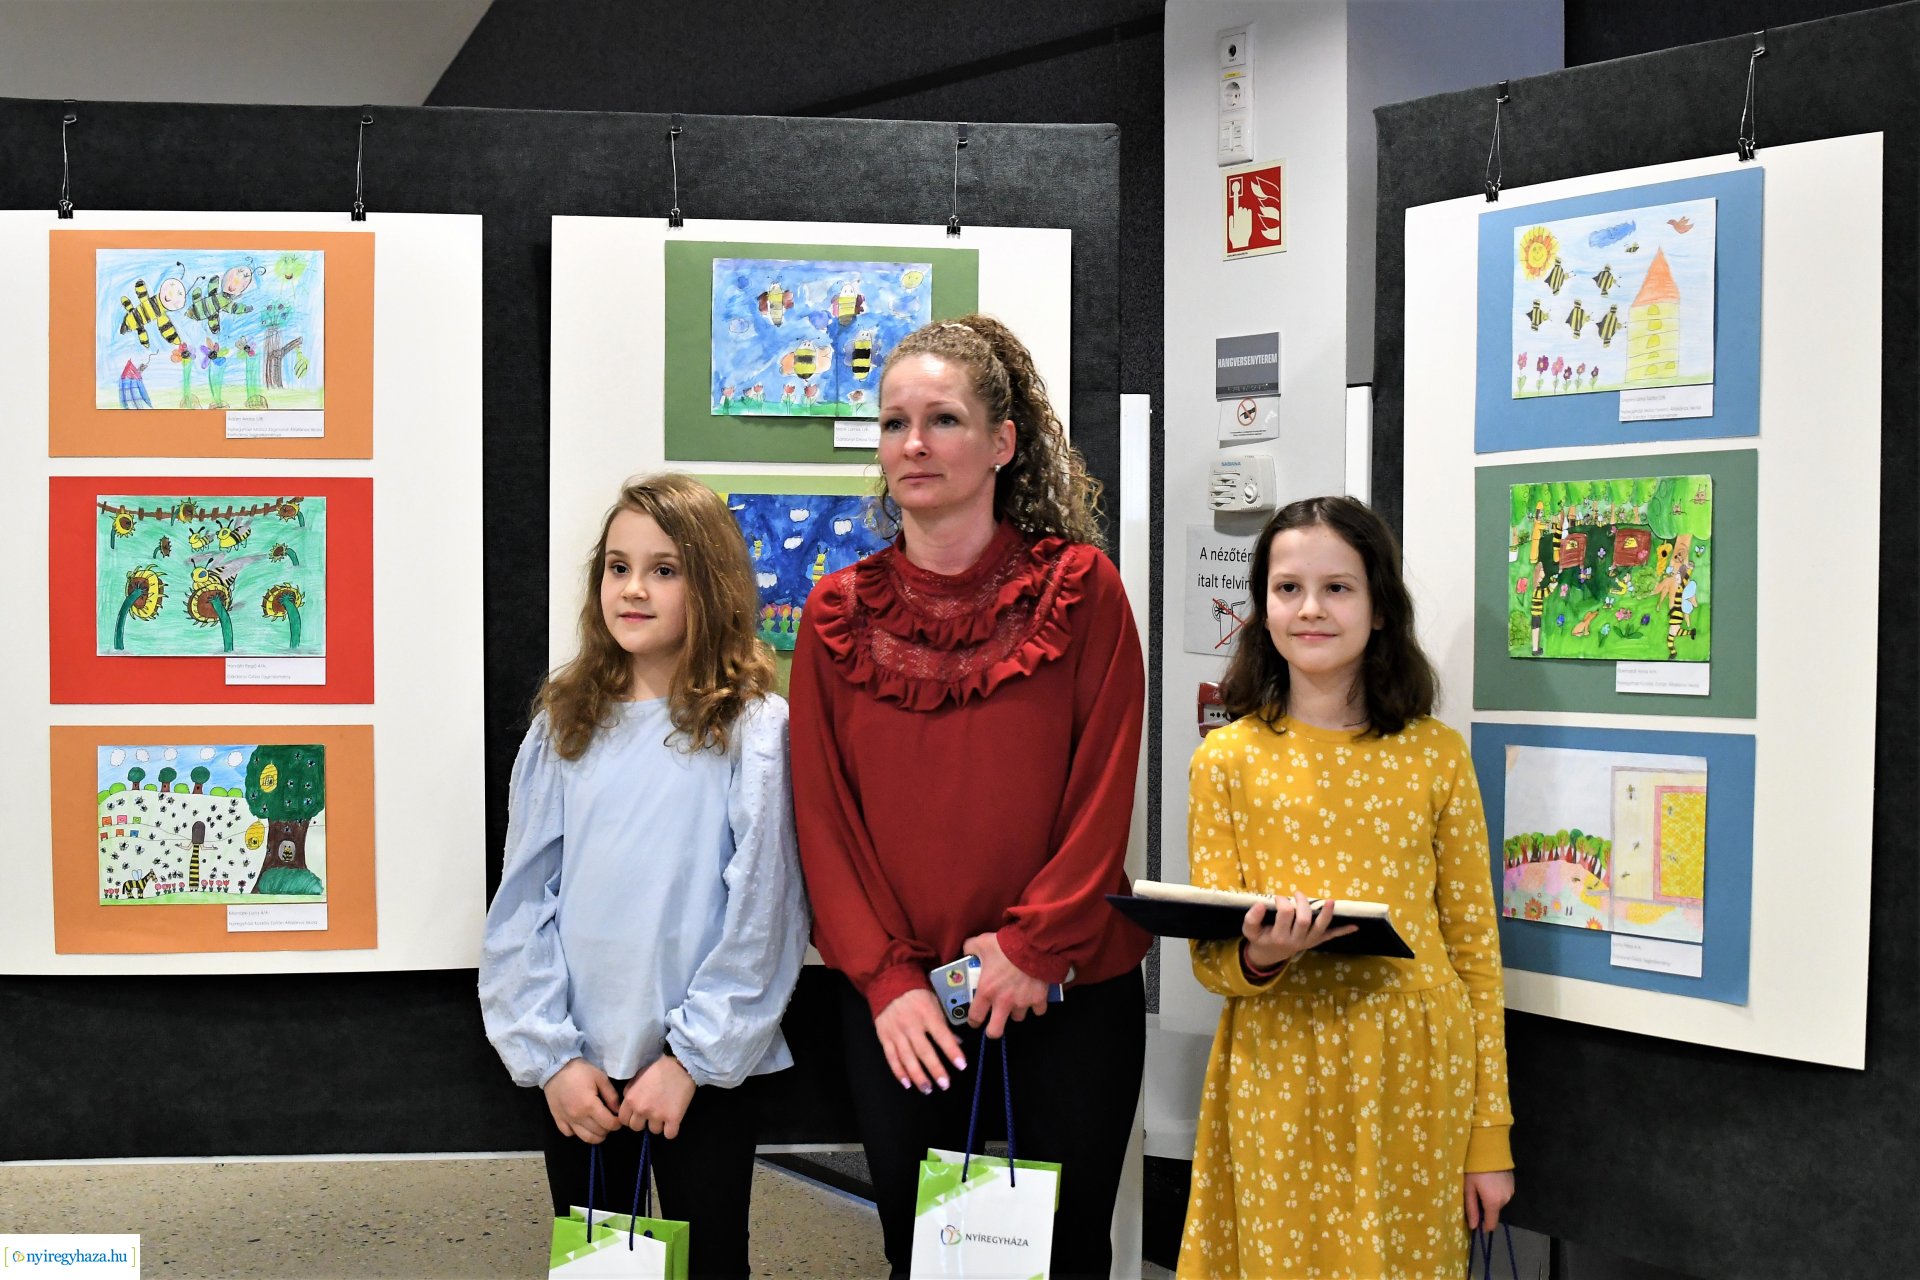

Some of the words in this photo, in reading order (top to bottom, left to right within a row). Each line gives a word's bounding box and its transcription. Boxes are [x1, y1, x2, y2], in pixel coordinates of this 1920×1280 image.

[1217, 353, 1278, 368] HANGVERSENYTEREM
[1199, 547, 1208, 560] A
[1197, 573, 1219, 589] italt
[965, 1232, 1029, 1247] NYÍREGYHÁZA
